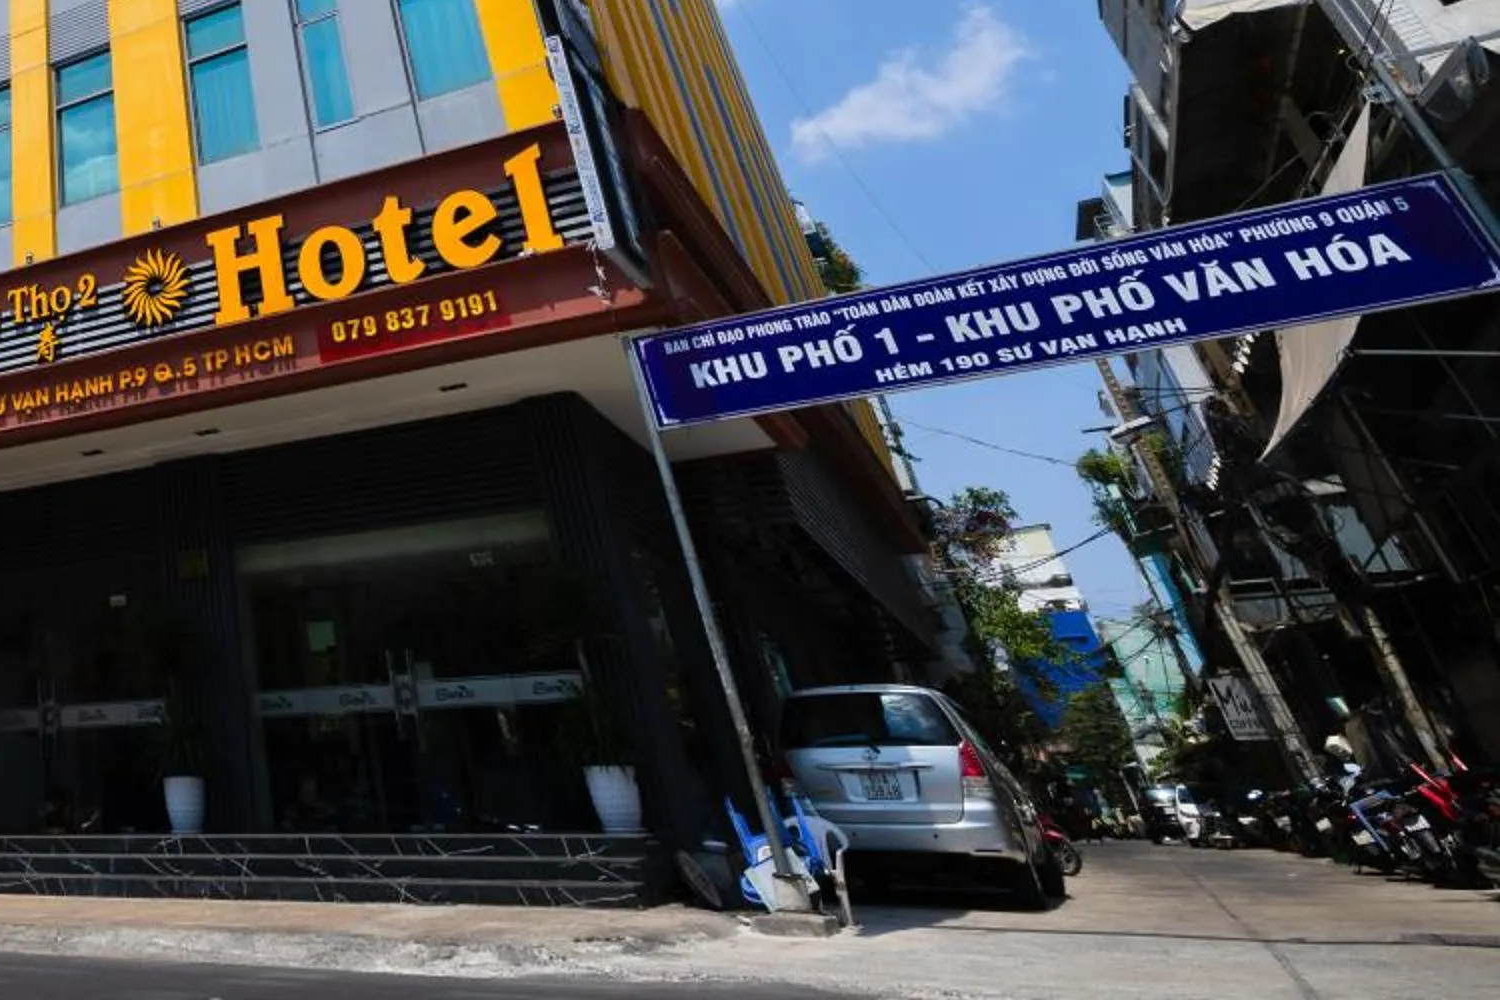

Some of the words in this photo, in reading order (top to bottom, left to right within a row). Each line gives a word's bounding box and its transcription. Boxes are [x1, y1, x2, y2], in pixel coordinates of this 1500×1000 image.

[206, 142, 564, 327] Hotel
[8, 282, 72, 322] Thọ
[77, 272, 98, 308] 2
[663, 338, 690, 356] BAN
[717, 327, 745, 345] ĐẠO
[746, 319, 793, 339] PHONG
[793, 310, 831, 330] TRÀO
[914, 286, 956, 308] ĐOÀN
[957, 277, 987, 299] KẾT
[989, 273, 1020, 294] XÂY
[1022, 265, 1067, 288] DỰNG
[1067, 257, 1100, 278] ĐỜI
[1101, 249, 1149, 272] SỐNG
[1149, 242, 1187, 262] VĂN
[1238, 215, 1319, 244] PHƯỜNG
[1319, 211, 1335, 228] 9
[1336, 199, 1392, 224] QUẬN
[1392, 195, 1411, 212] 5
[688, 351, 769, 389] KHU
[777, 323, 863, 373] PHỐ
[873, 326, 900, 356] 1
[944, 301, 1042, 344] KHU
[1050, 269, 1156, 326] PHỐ
[1161, 256, 1278, 303] VĂN
[1284, 232, 1412, 281] HÓA
[331, 314, 378, 344] 079
[385, 303, 430, 334] 837
[440, 290, 498, 322] 9191
[939, 351, 991, 372] 190
[996, 341, 1034, 363] SƯ
[1040, 332, 1100, 356] VẠN
[1103, 316, 1188, 344] HẠNH
[11, 386, 50, 415] VẠN
[55, 370, 114, 403] HẠNH
[118, 365, 147, 392] P.9
[201, 345, 229, 373] TP
[234, 335, 294, 367] HCM
